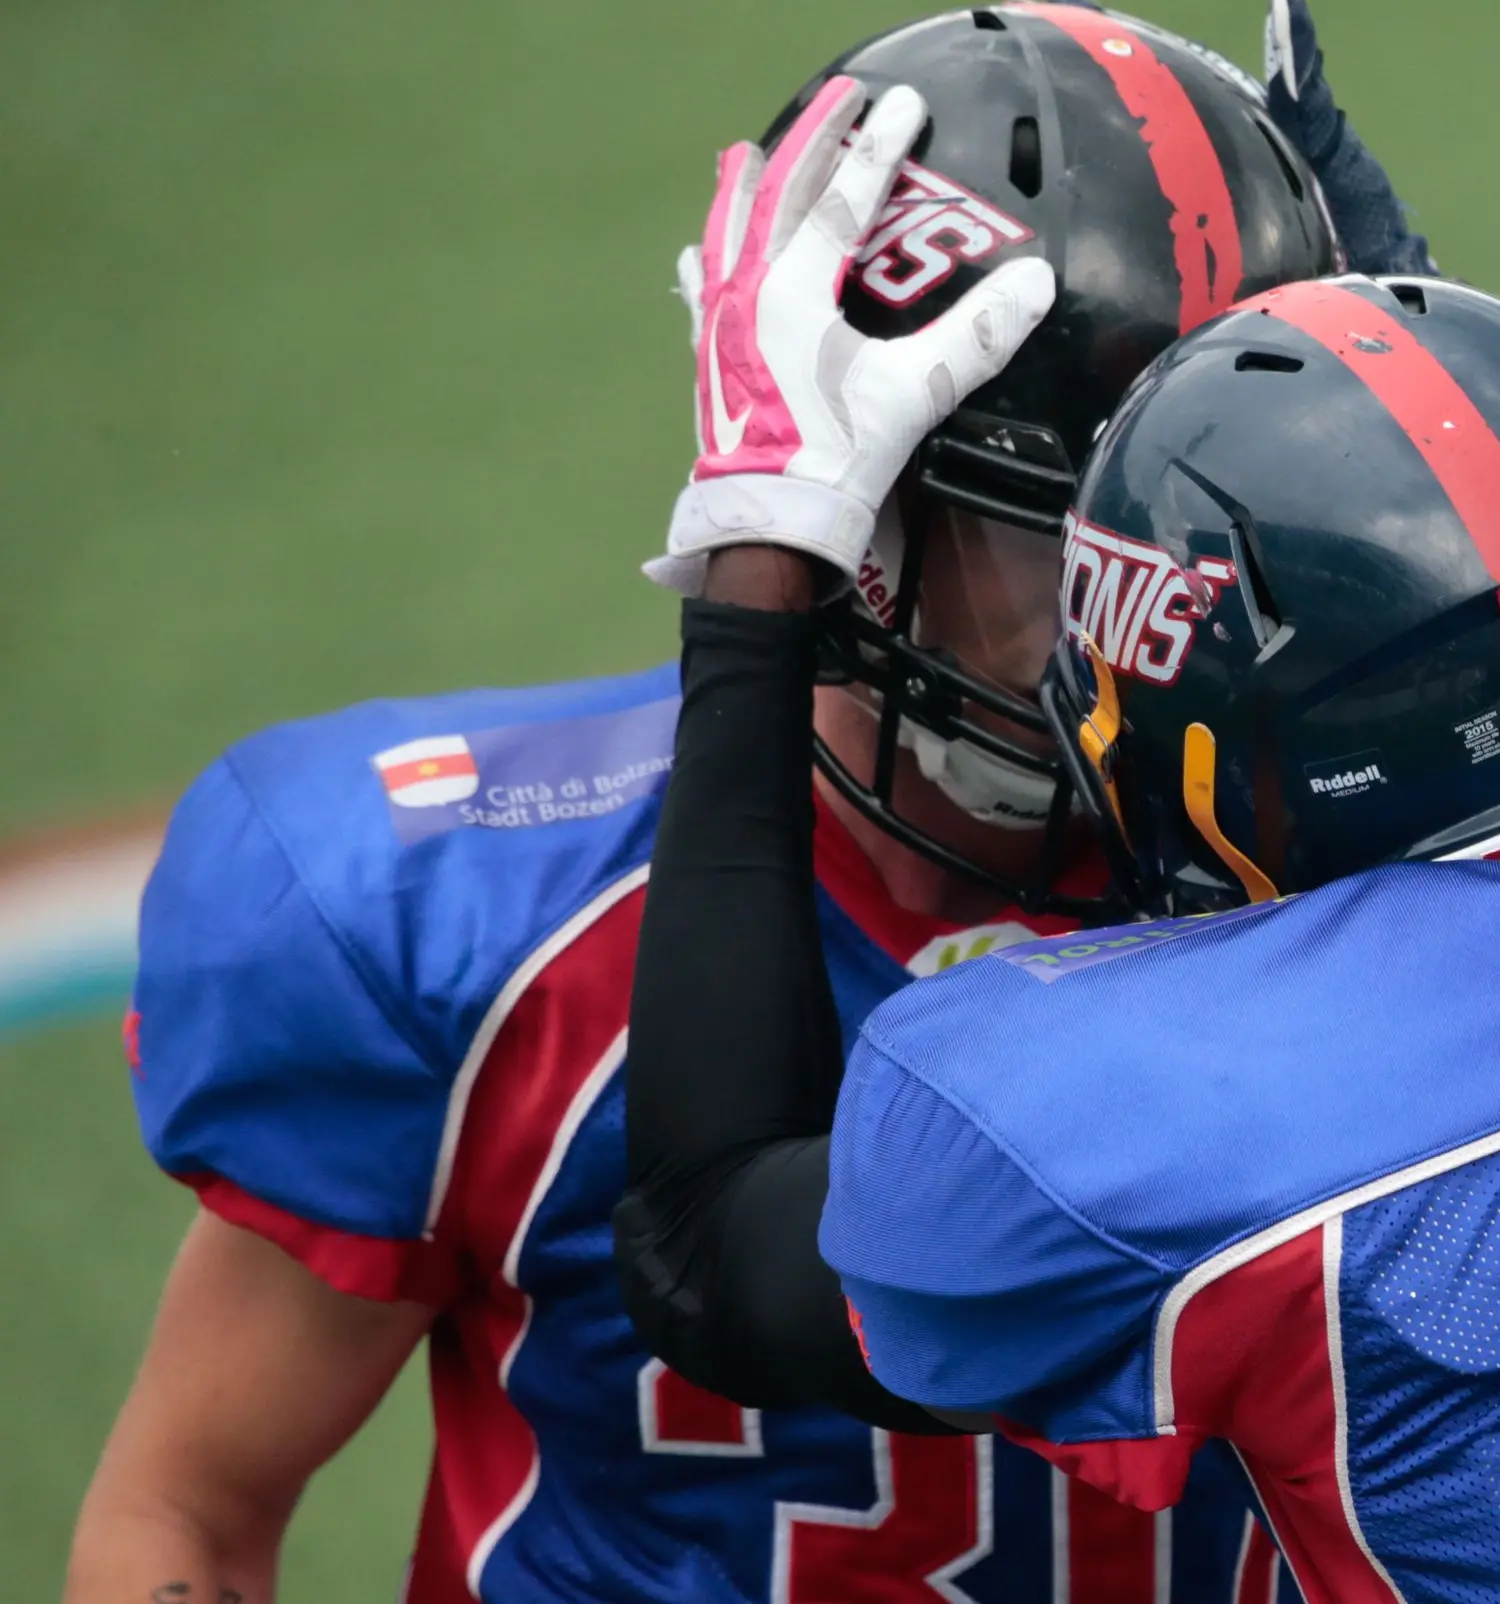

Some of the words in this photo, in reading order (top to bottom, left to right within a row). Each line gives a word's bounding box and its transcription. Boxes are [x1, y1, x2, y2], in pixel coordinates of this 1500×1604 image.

[1465, 720, 1494, 740] 2015
[560, 776, 588, 799] di
[593, 756, 677, 795] Bolza
[1310, 764, 1381, 793] Riddell
[1331, 784, 1370, 798] MEDIUM
[458, 803, 532, 828] Stadt
[537, 793, 625, 822] Bozen
